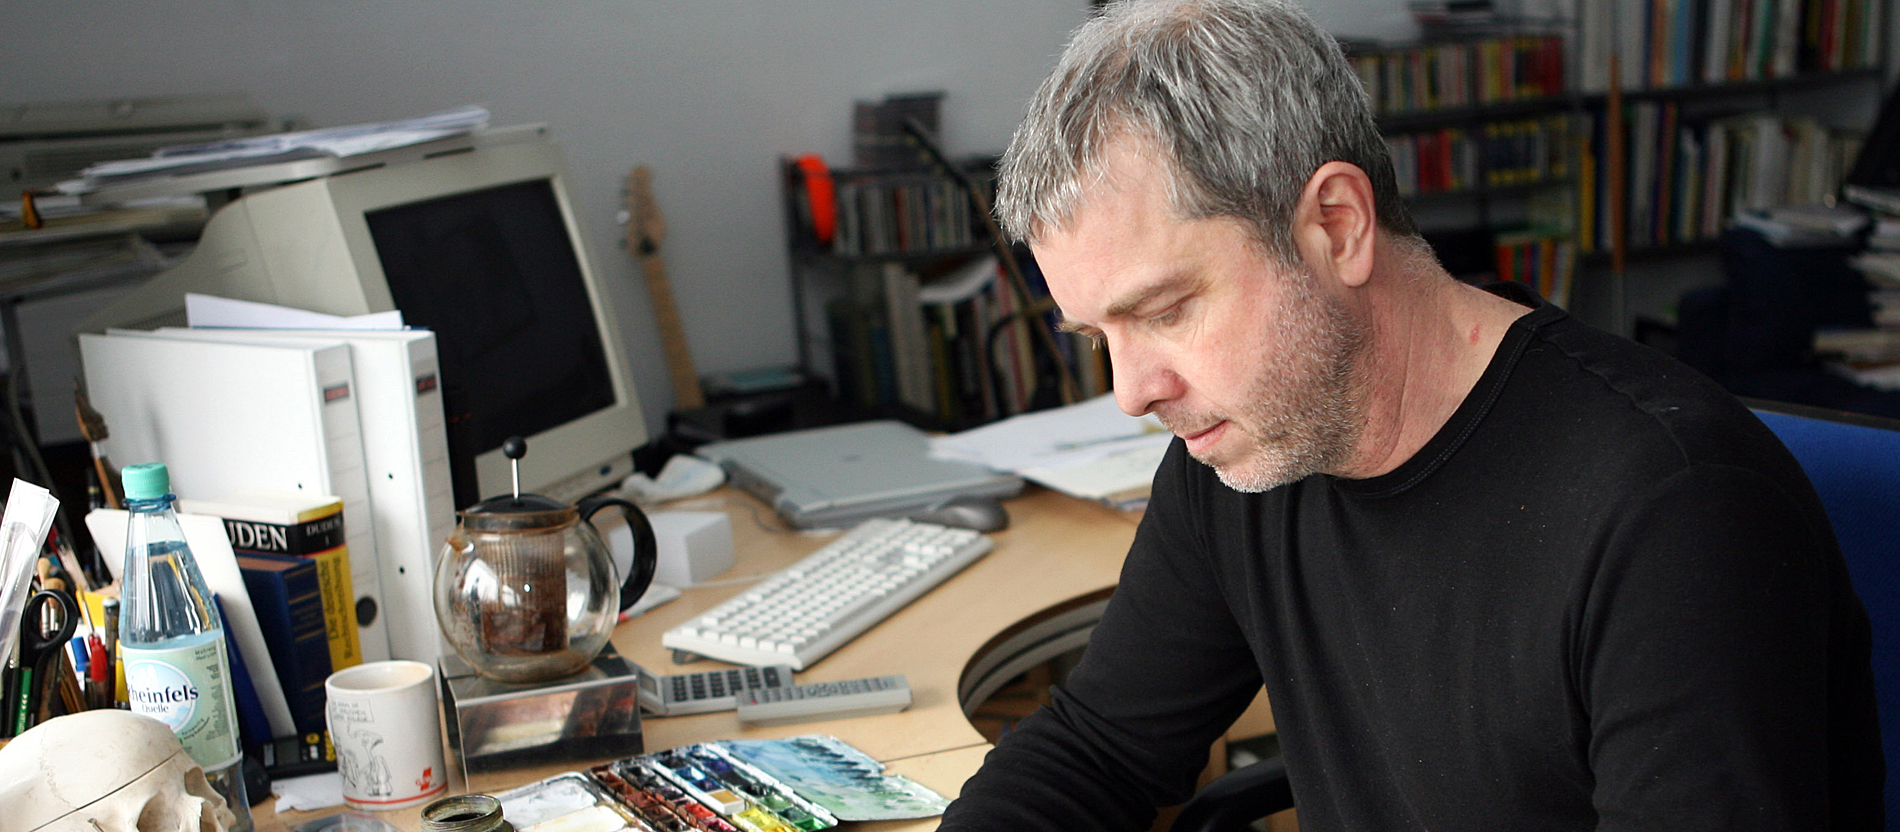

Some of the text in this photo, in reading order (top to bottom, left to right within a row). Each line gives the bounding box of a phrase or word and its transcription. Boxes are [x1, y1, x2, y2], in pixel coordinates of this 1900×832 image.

[305, 516, 342, 536] DUDEN
[228, 522, 288, 551] UDEN
[141, 703, 170, 714] Quelle
